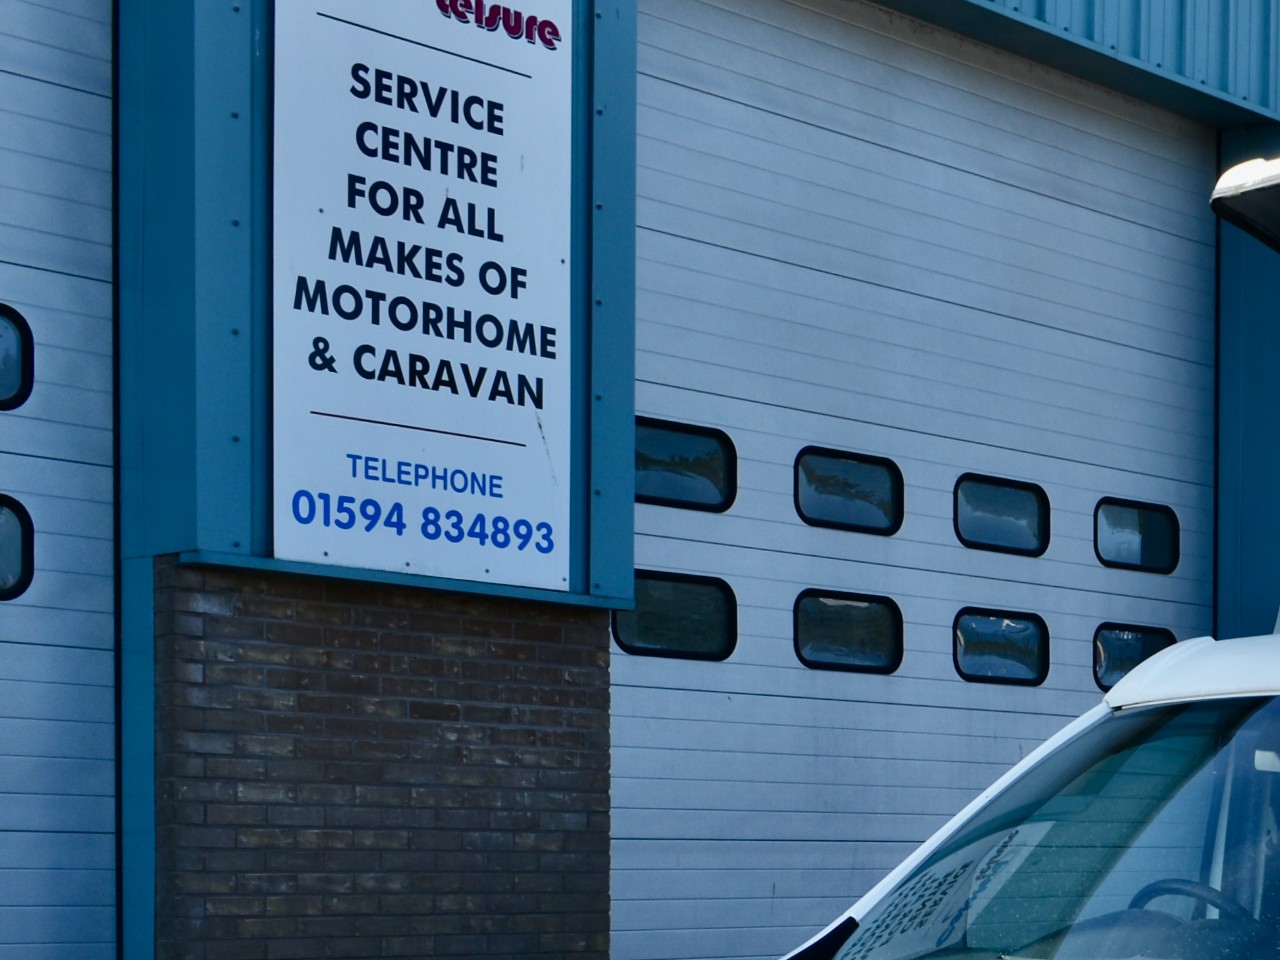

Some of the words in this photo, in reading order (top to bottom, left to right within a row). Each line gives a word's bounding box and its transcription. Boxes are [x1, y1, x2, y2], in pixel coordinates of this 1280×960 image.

[350, 62, 504, 136] SERVICE
[355, 121, 498, 188] CENTRE
[347, 173, 425, 225] FOR
[437, 196, 504, 243] ALL
[328, 226, 465, 287] MAKES
[478, 261, 527, 299] OF
[293, 275, 557, 360] MOTORHOME
[308, 336, 339, 374] &
[352, 344, 544, 410] CARAVAN
[346, 453, 504, 498] TELEPHONE
[292, 489, 407, 536] 01594
[420, 506, 555, 554] 834893
